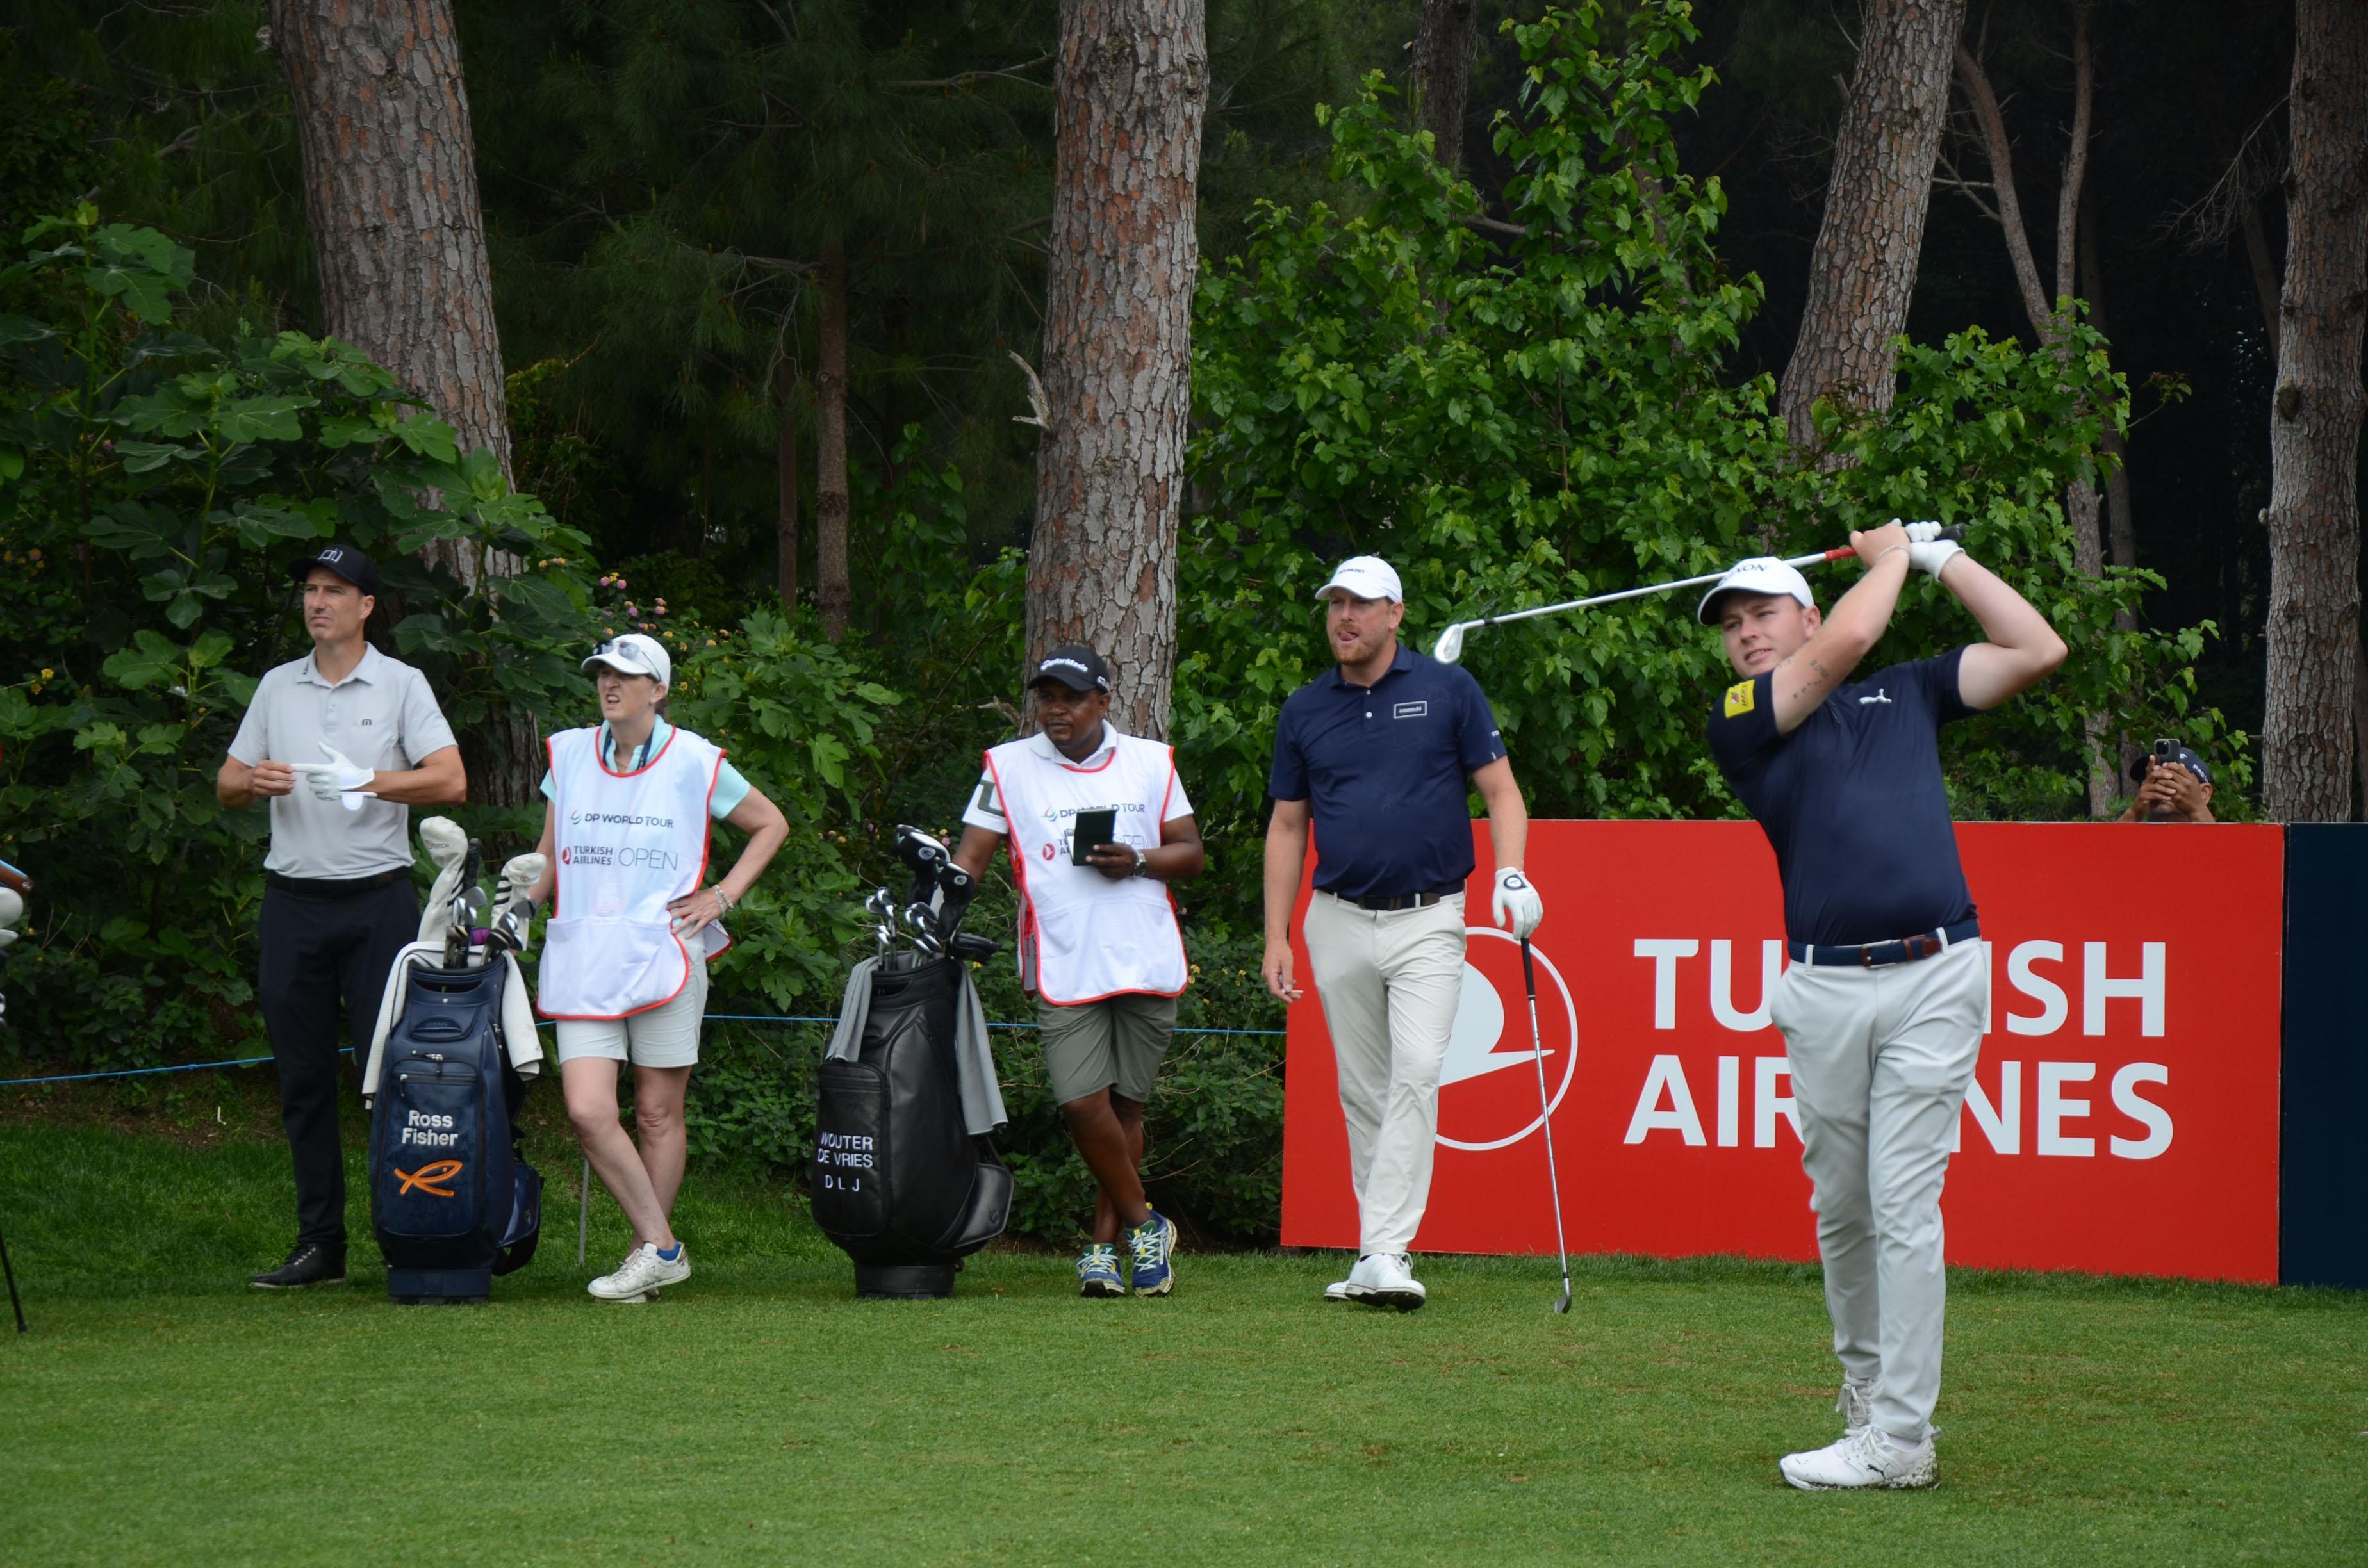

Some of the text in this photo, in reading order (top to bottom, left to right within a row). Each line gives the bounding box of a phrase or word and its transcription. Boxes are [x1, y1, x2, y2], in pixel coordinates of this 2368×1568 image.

[1060, 809, 1076, 818] DP
[1121, 803, 1145, 813] TOUR
[584, 813, 673, 828] DP WORLD TOUR
[573, 845, 613, 855] TURKISH
[618, 847, 678, 871] OPEN
[573, 856, 613, 865] AIRLINES
[1634, 938, 2166, 1037] TUSH
[1623, 1054, 2173, 1160] AIRNES
[408, 1109, 454, 1128] Ross
[402, 1127, 459, 1146] Fisher
[821, 1132, 873, 1150] WOUTER
[817, 1148, 873, 1168] DE VRIES
